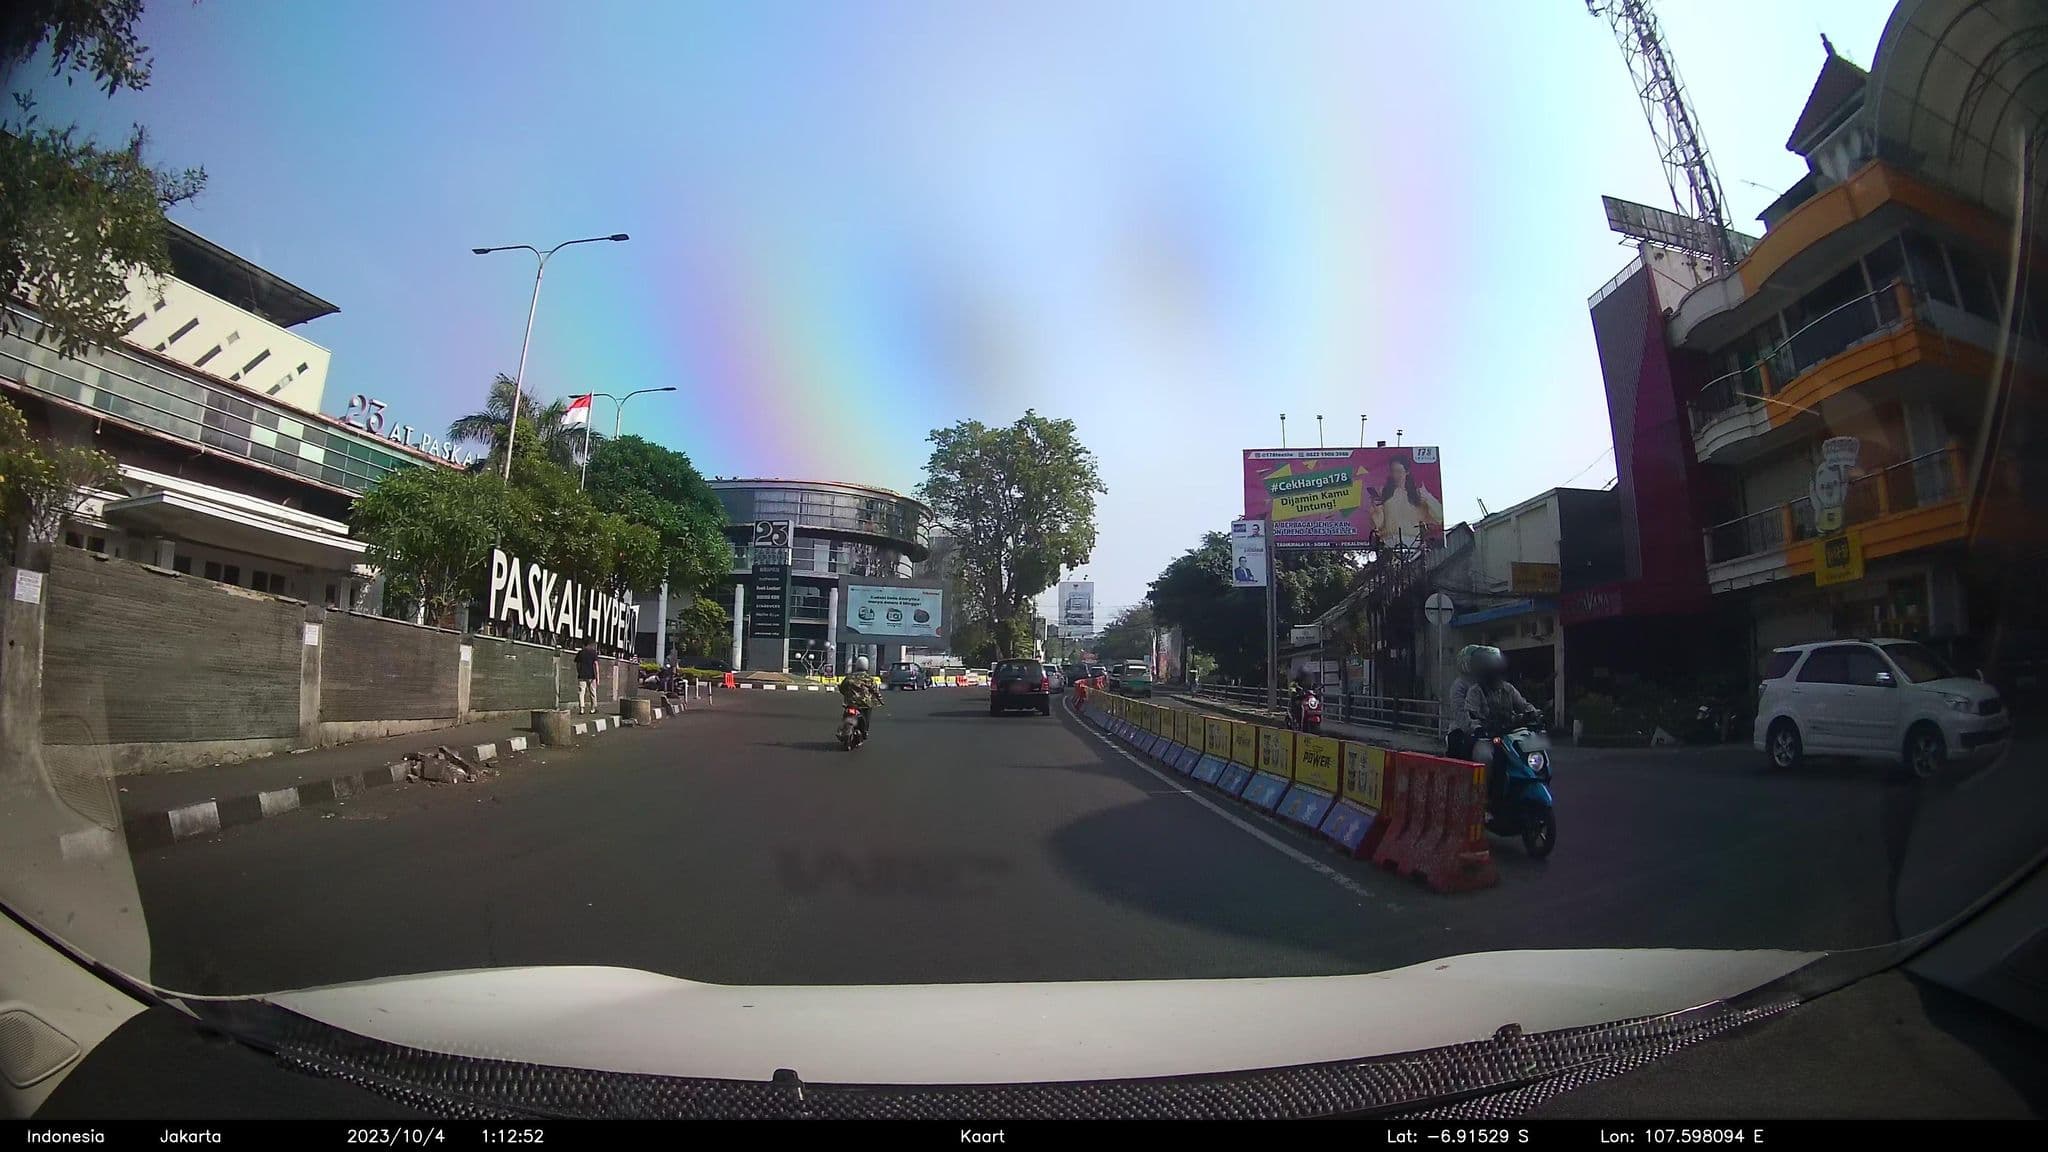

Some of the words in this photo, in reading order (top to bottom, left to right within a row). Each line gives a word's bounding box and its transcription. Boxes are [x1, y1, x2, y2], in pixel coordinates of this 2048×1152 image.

[345, 394, 388, 434] 23
[388, 422, 415, 446] AT
[1270, 472, 1348, 493] #CekHarga178
[1281, 493, 1319, 506] Dijamin
[1321, 489, 1350, 500] Kamu
[1296, 499, 1337, 512] Untung!
[755, 520, 788, 547] 23
[489, 548, 584, 639] PASKAL
[1302, 751, 1332, 768] POWER
